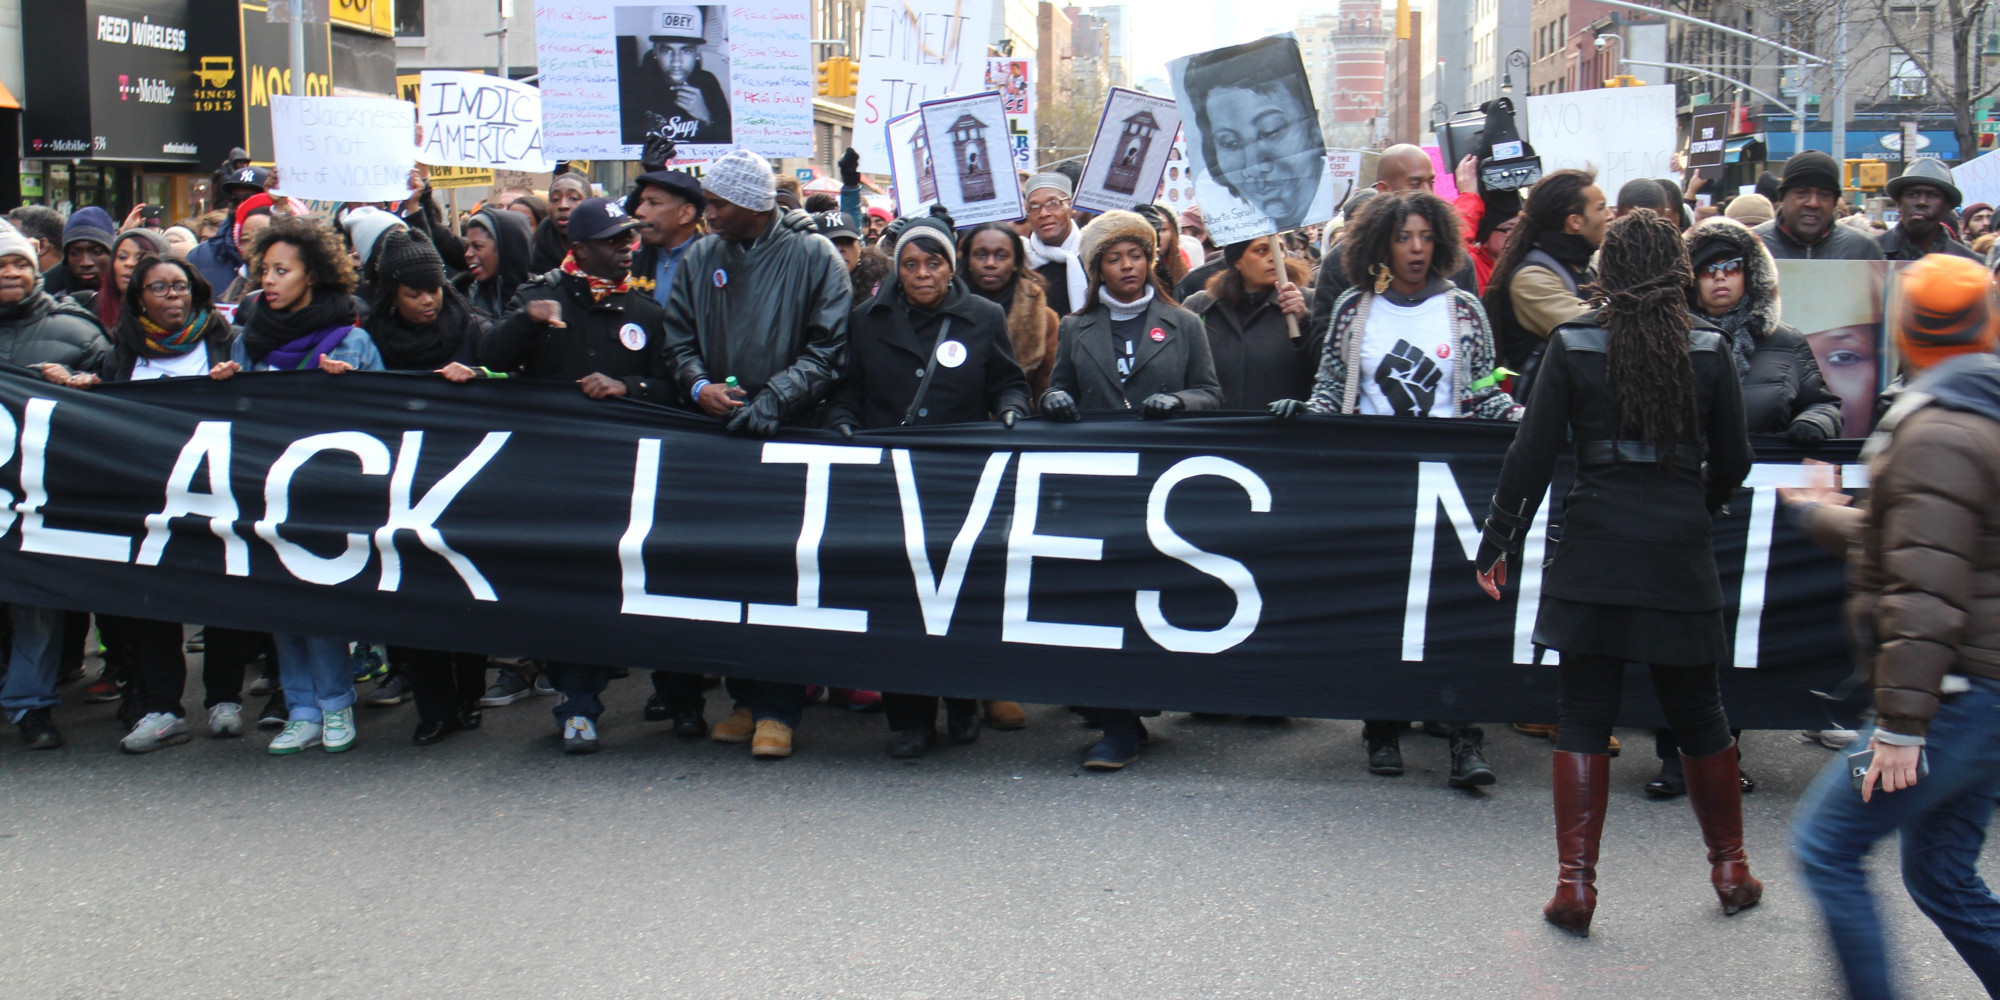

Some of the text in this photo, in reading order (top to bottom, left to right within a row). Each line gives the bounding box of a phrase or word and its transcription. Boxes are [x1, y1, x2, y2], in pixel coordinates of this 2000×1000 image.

[97, 15, 130, 44] REED
[665, 15, 692, 27] OBEY
[869, 5, 970, 65] EMMETT
[195, 100, 232, 111] 1915
[1537, 102, 1581, 137] NO
[324, 134, 367, 155] not
[424, 119, 546, 166] AMERICA
[618, 437, 1273, 655] LIVES
